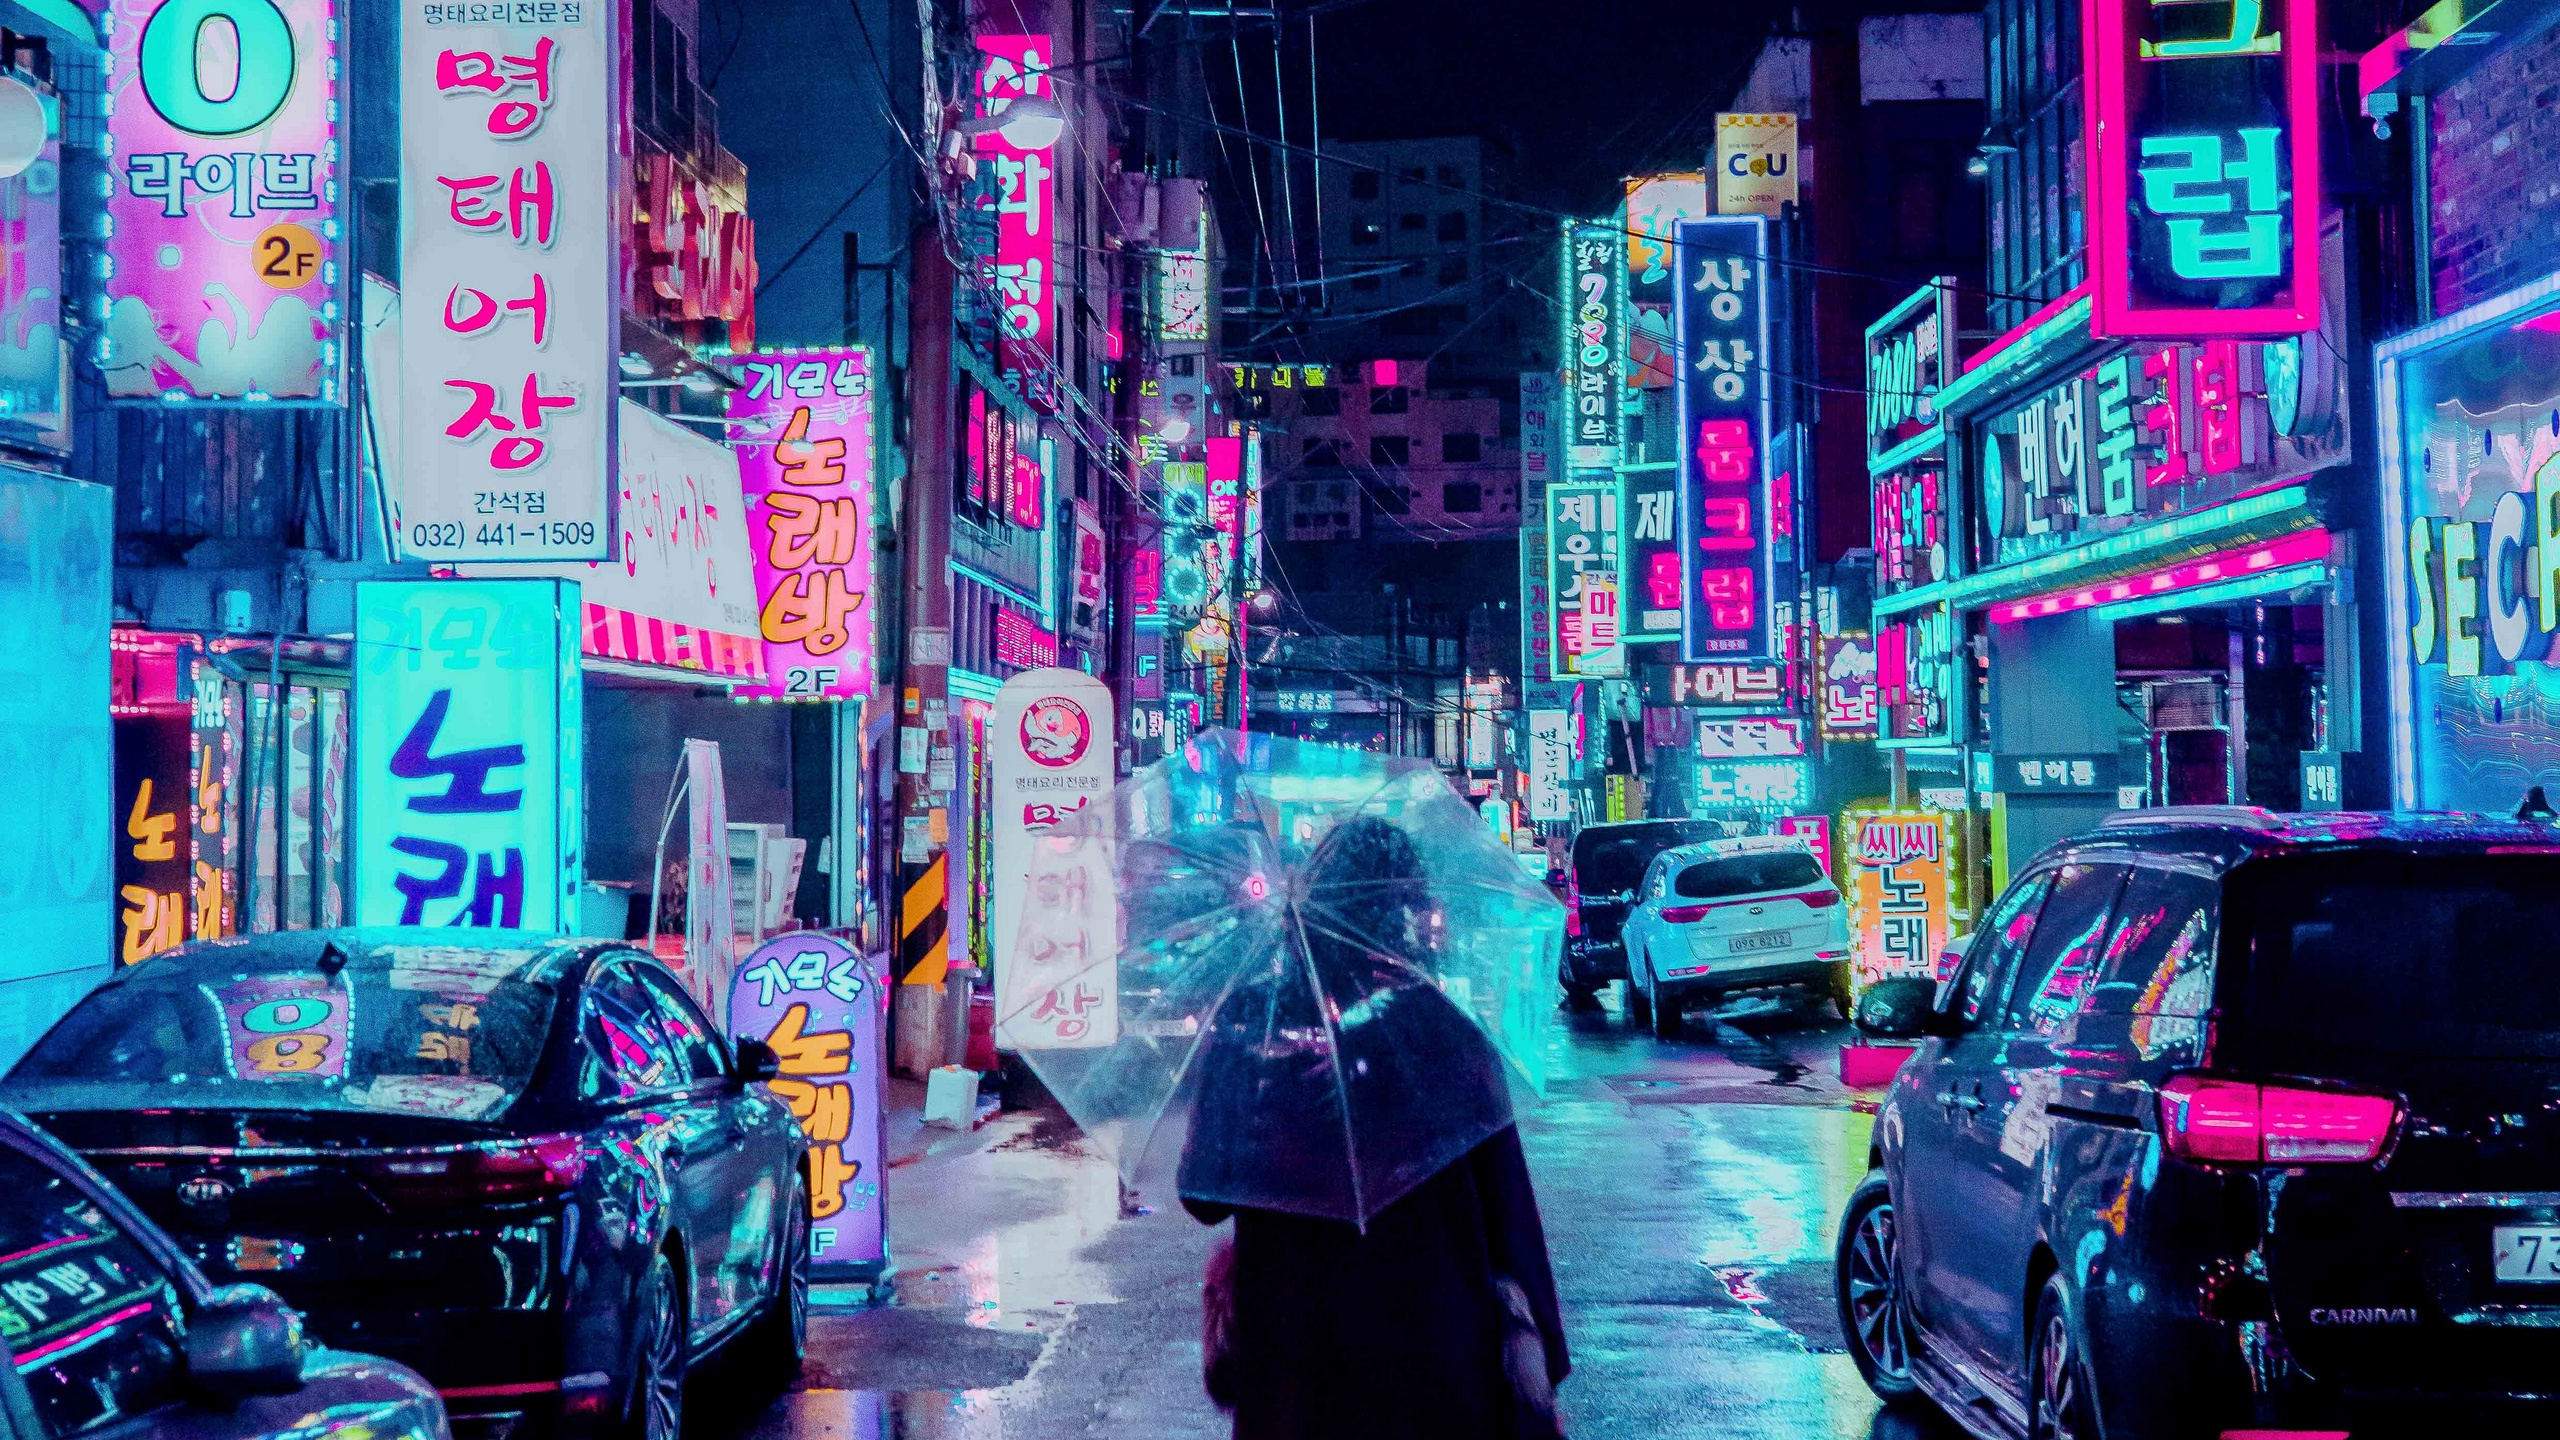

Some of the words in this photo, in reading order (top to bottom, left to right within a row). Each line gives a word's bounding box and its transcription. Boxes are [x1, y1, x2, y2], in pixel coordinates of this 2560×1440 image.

[126, 152, 318, 217] 라이브
[263, 236, 315, 276] 2F
[436, 36, 578, 470] 명태어장
[746, 360, 867, 399] 기모노
[474, 490, 546, 516] 간석점
[413, 521, 465, 549] 032)
[475, 520, 595, 547] 441-1509
[760, 406, 864, 656] 노래방
[1590, 591, 1617, 647] 마트
[786, 666, 838, 695] 2F
[121, 777, 184, 967] 노래
[1880, 865, 1929, 982] 노래
[745, 952, 863, 1006] 기모노
[766, 1001, 862, 1222] 노래방
[2309, 1308, 2421, 1325] CARNIVAL
